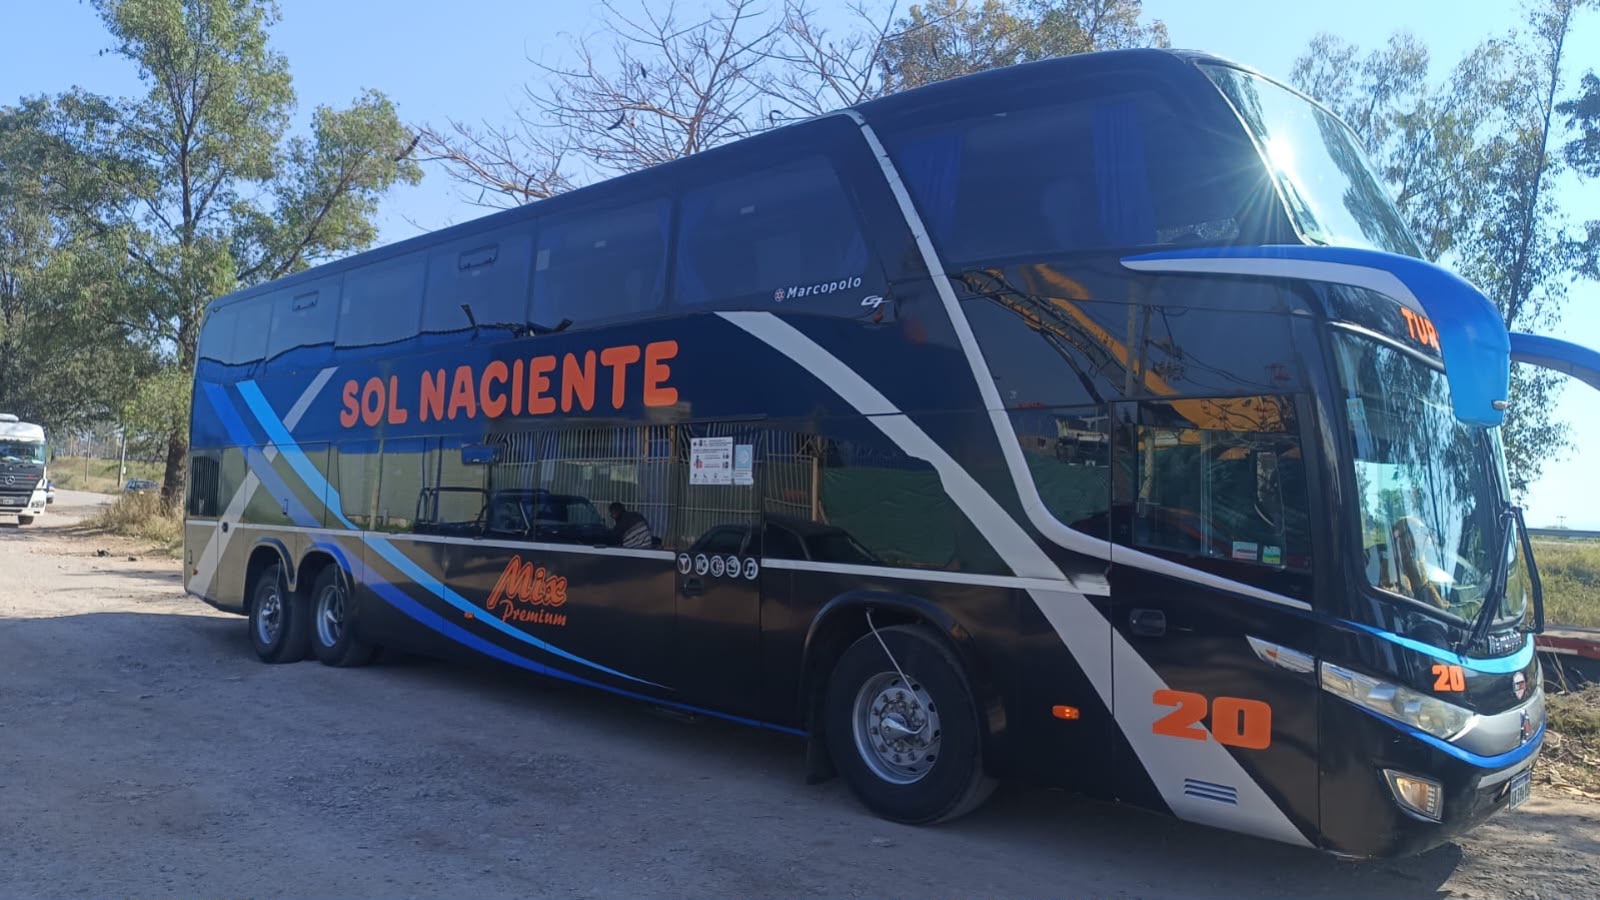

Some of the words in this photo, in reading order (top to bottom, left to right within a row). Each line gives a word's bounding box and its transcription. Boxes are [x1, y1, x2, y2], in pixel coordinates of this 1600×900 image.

[786, 276, 862, 299] Marcopolo
[1400, 306, 1440, 351] TUR
[340, 375, 408, 428] SOL
[419, 340, 679, 422] NACIENTE
[487, 554, 567, 610] Mix
[499, 600, 567, 626] Premium
[1431, 664, 1465, 692] 20
[1152, 689, 1272, 750] 20
